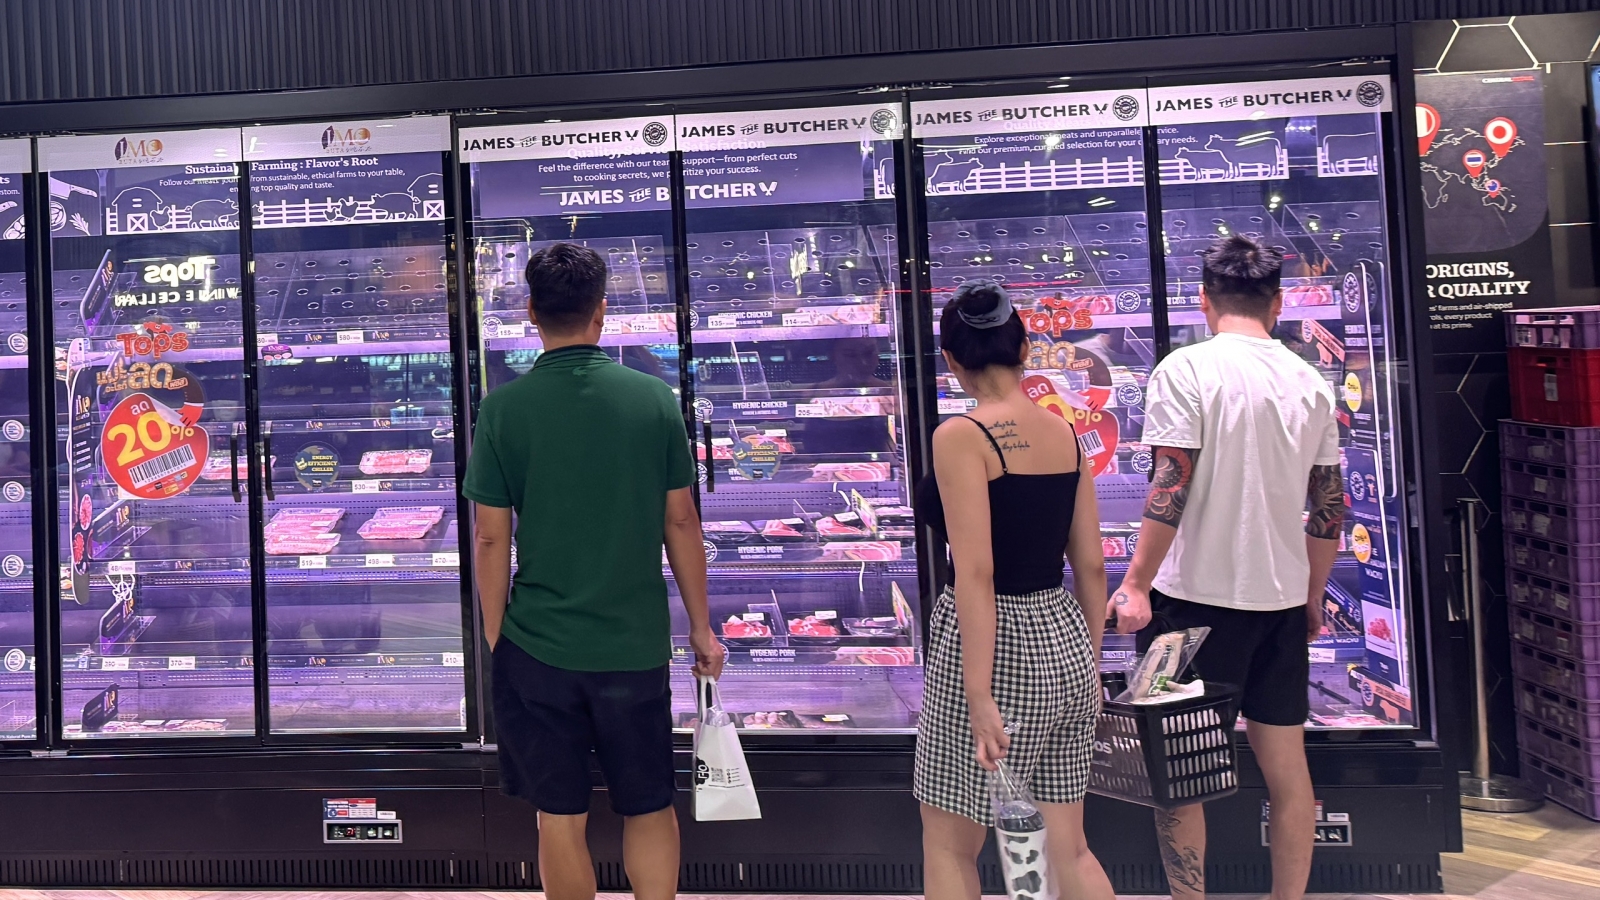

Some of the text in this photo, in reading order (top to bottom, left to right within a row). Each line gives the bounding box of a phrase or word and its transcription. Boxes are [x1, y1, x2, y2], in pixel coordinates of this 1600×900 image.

[1156, 90, 1333, 112] JAMES THE BUTCHER
[915, 104, 1090, 126] JAMES THE BUTCHER
[682, 118, 849, 138] JAMES THE BUTCHER
[974, 135, 1005, 146] Explore
[1080, 130, 1096, 139] and
[1097, 128, 1142, 141] unparallele
[463, 130, 622, 151] JAMES THE BUTCHER
[567, 147, 621, 161] Quality,
[682, 138, 766, 153] Satisfaction
[978, 147, 993, 155] our
[993, 144, 1033, 156] premium,
[1067, 140, 1103, 150] selection
[1104, 138, 1116, 148] for
[1117, 140, 1137, 151] your
[1171, 135, 1198, 145] needs.
[251, 161, 298, 176] Farming
[306, 157, 350, 173] Flavor's
[351, 156, 379, 171] Root
[538, 164, 556, 173] Feel
[557, 163, 571, 172] the
[573, 161, 614, 171] difference
[616, 160, 634, 169] with
[746, 152, 778, 165] perfect
[779, 152, 798, 161] cuts
[159, 176, 183, 188] Follow
[250, 174, 267, 183] from
[268, 171, 310, 183] sustainable,
[311, 170, 335, 180] ethical
[336, 170, 357, 180] farms
[358, 170, 366, 178] to
[366, 170, 384, 180] your
[384, 167, 406, 178] table,
[573, 173, 583, 182] to
[584, 171, 617, 183] cooking
[617, 170, 650, 181] secrets,
[705, 167, 725, 178] your
[727, 165, 762, 175] success.
[260, 181, 335, 193] top quality and taste.
[559, 182, 757, 206] JAMES THE BTCHER
[1438, 281, 1531, 302] QUALITY
[746, 310, 773, 318] CHICKEN
[1018, 309, 1094, 338] Tops
[1464, 312, 1493, 322] product
[116, 331, 190, 360] Tops
[761, 400, 788, 409] CHICKEN
[1027, 387, 1050, 402] ลด
[129, 400, 151, 416] ลด
[107, 411, 195, 467] 20%
[737, 545, 784, 555] HYGIENIC PORK
[750, 648, 797, 658] HYGIENIC PORK
